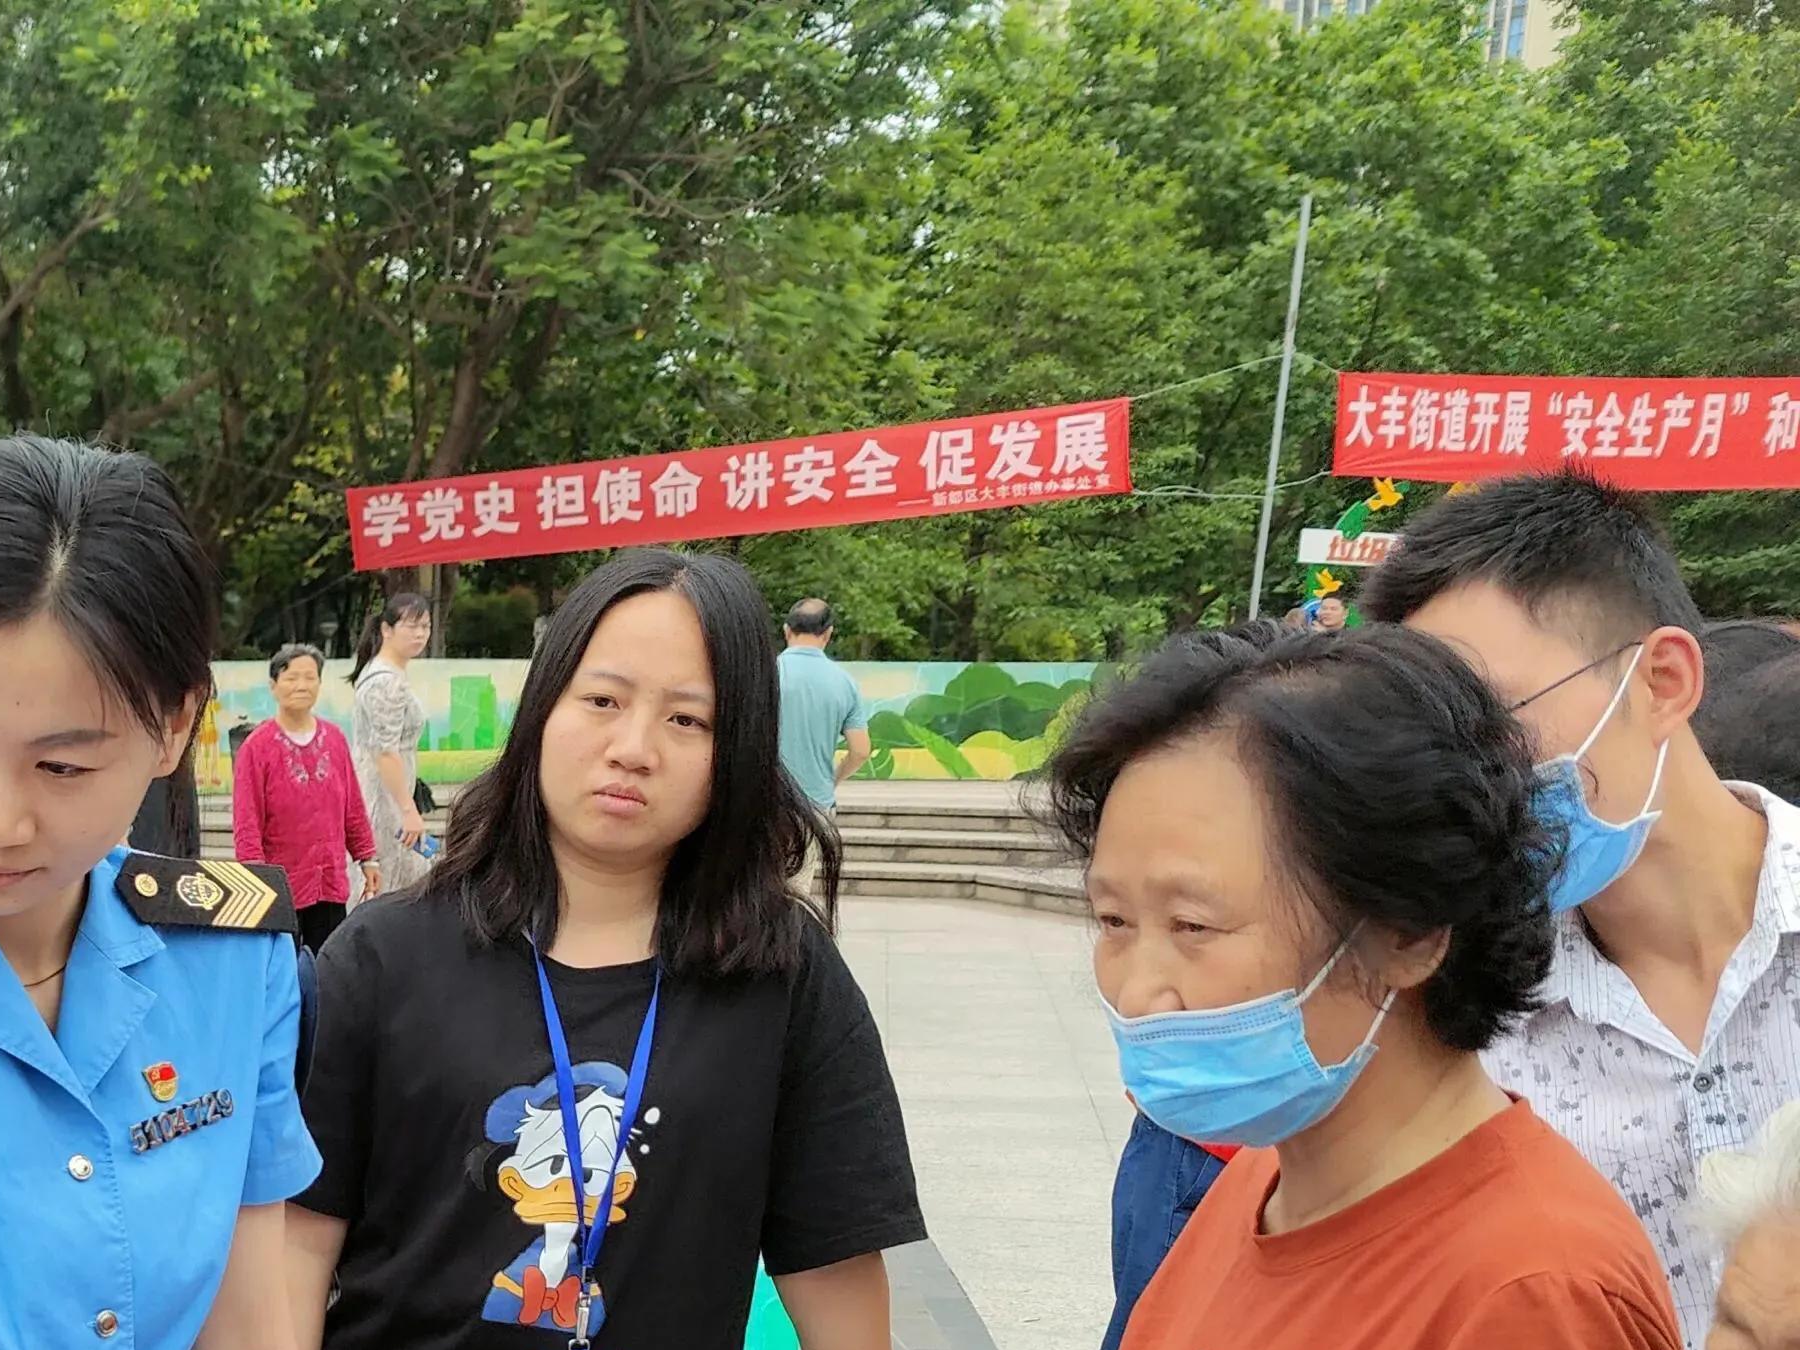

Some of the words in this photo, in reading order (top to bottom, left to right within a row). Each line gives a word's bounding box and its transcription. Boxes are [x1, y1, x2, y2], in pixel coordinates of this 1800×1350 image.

[362, 481, 520, 548] 学党史
[536, 460, 702, 529] 担使命
[720, 438, 900, 511] 讲安全
[917, 411, 1109, 489] 促发展
